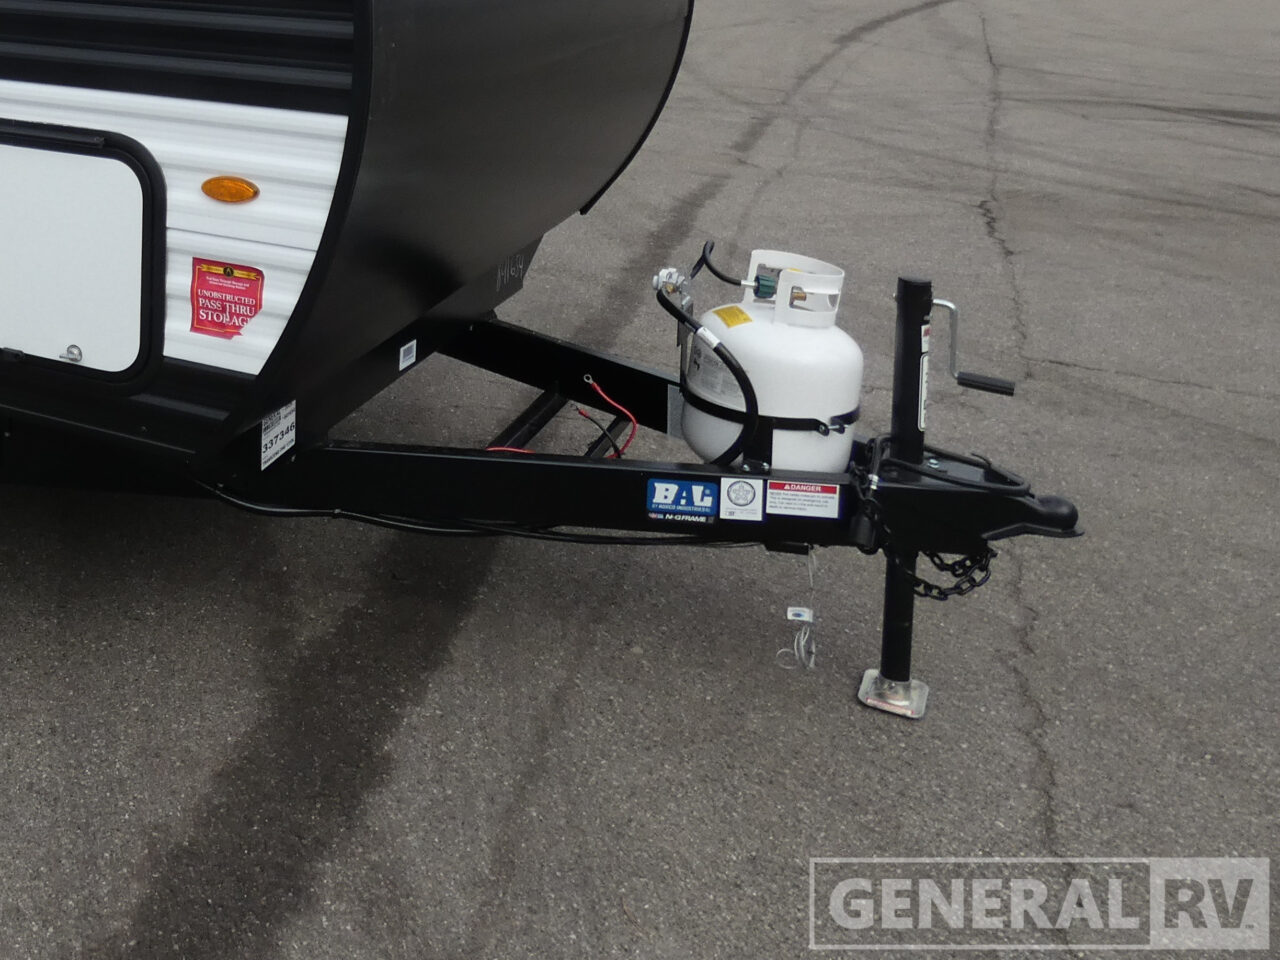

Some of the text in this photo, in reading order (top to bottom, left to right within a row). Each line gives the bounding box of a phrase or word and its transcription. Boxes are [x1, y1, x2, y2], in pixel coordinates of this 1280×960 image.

[198, 289, 256, 306] UNOBSTRUCTED
[199, 298, 255, 317] PASS THRU
[790, 484, 821, 492] DANGER
